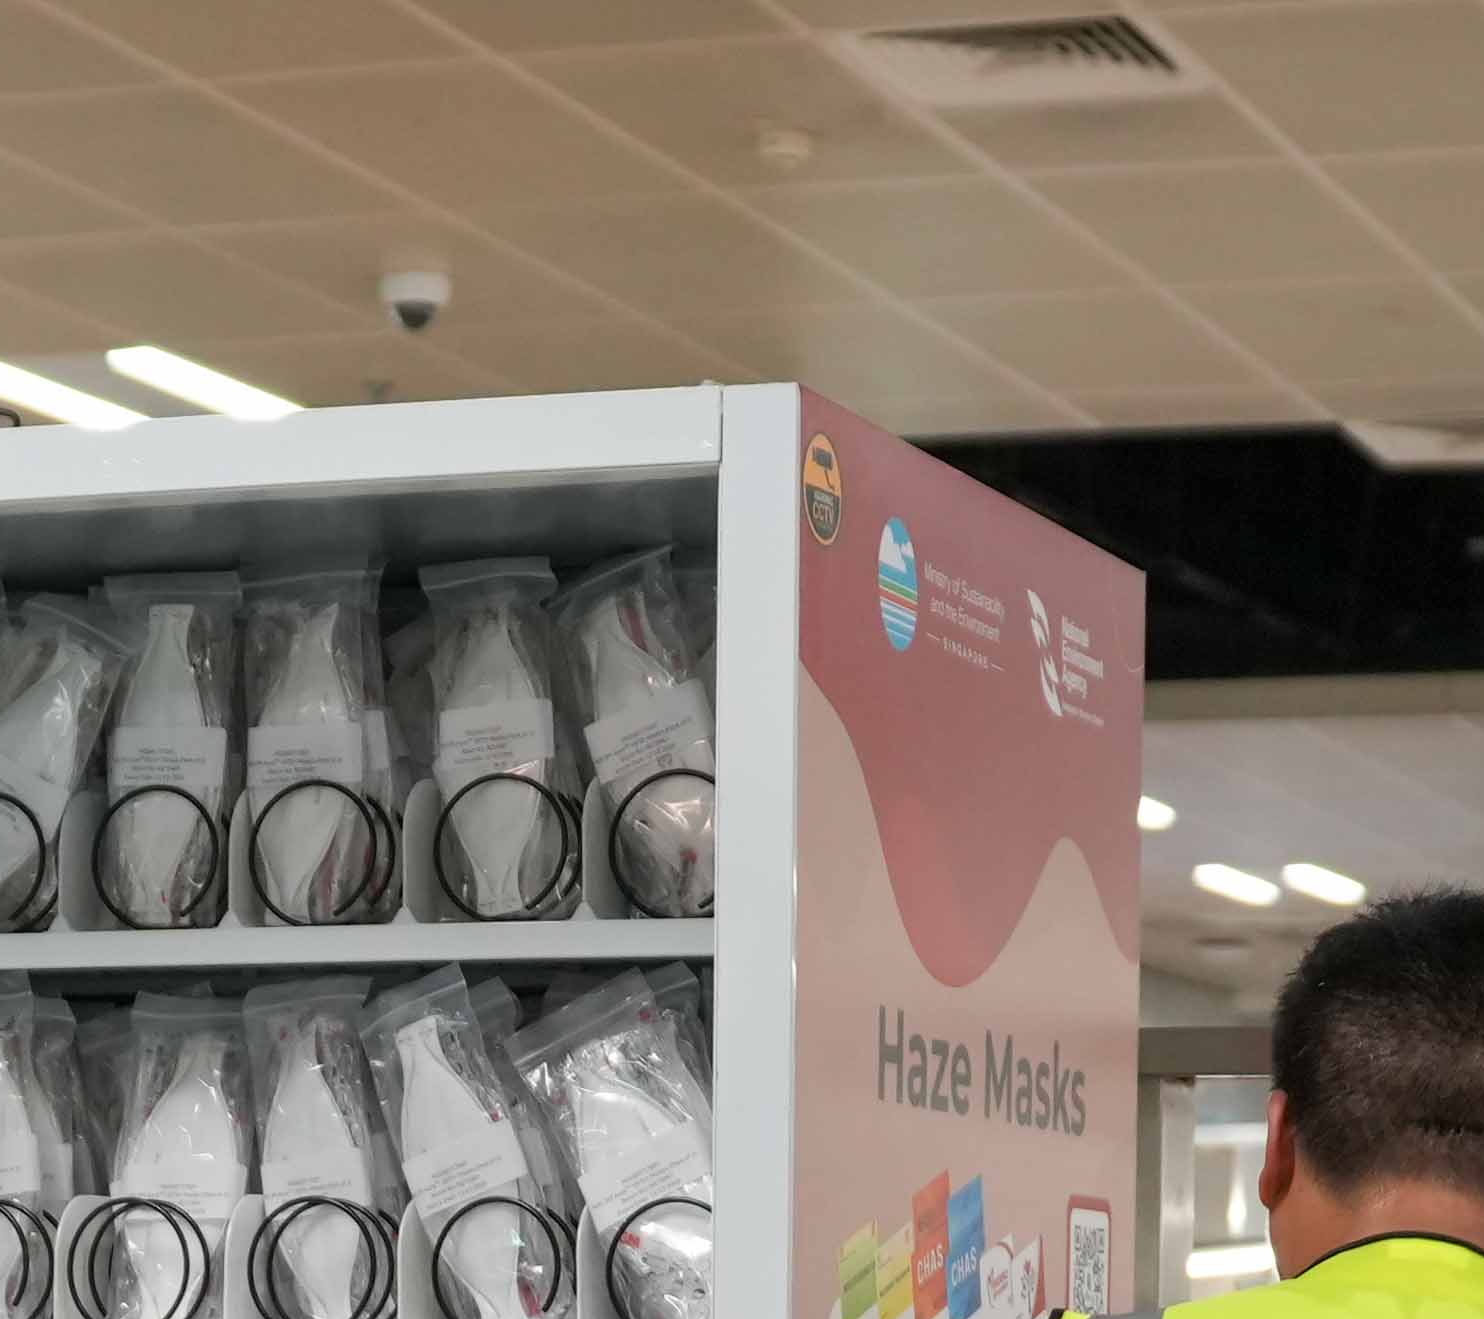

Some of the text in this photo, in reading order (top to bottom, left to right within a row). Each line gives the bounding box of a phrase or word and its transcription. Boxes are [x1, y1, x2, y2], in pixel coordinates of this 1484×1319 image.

[877, 1004, 1087, 1137] Haze Masks
[916, 1243, 944, 1284] CHAS
[951, 1246, 977, 1287] CHAS
